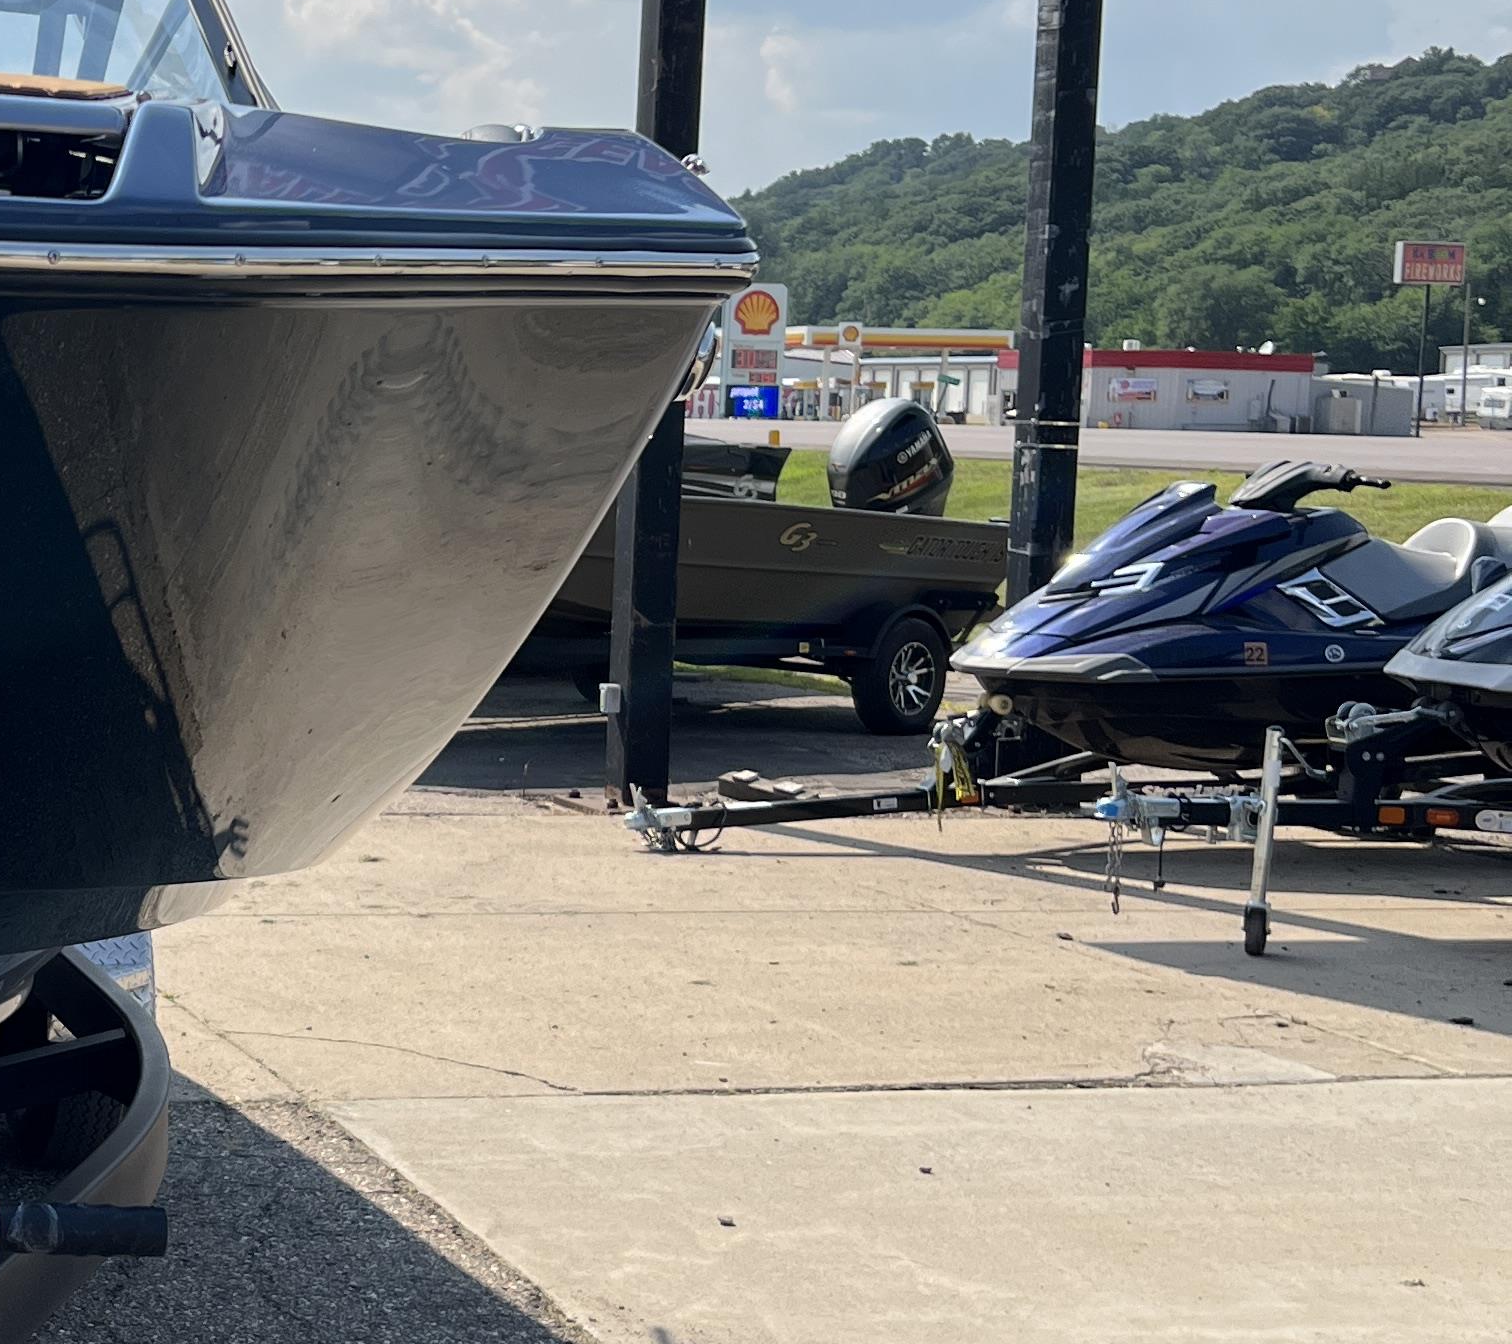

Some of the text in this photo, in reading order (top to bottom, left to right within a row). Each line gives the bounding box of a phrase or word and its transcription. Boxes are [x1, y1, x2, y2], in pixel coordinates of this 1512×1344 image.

[1404, 262, 1462, 281] FIREWORKS
[905, 429, 933, 459] YAMAHA
[779, 522, 818, 552] G3
[1246, 647, 1266, 663] 22
